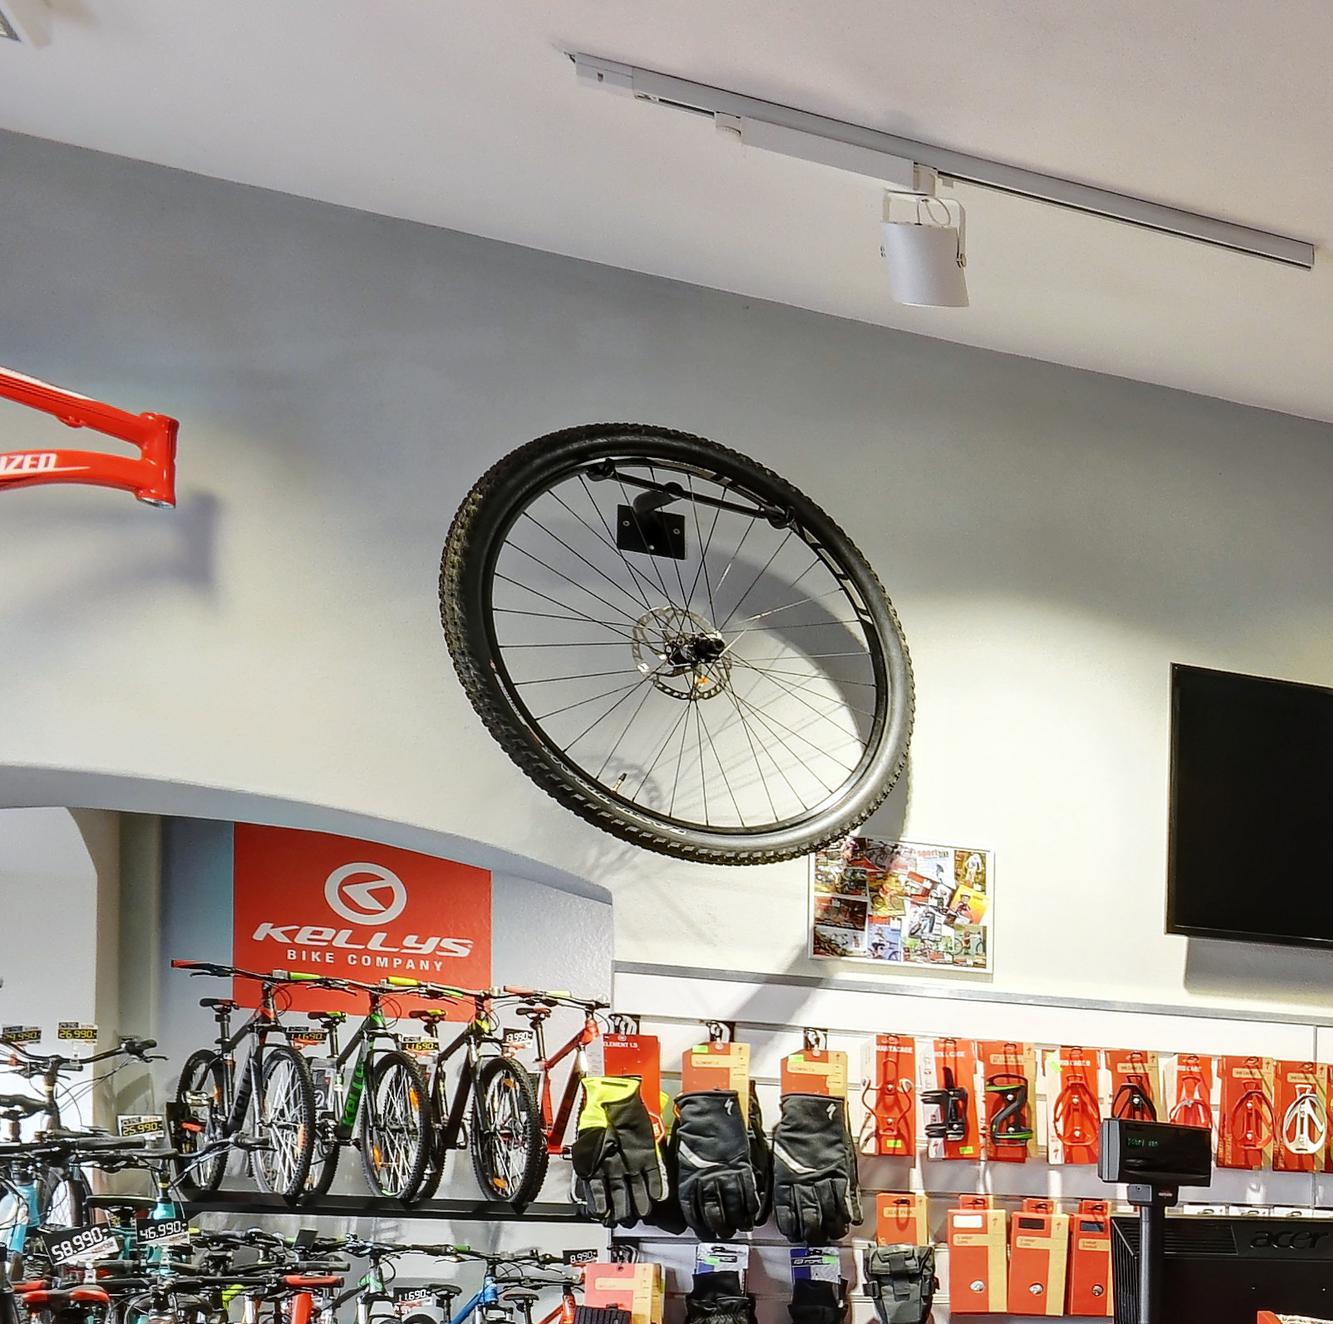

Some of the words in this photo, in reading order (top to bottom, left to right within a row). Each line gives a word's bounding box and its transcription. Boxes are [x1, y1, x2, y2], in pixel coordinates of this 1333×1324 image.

[287, 949, 335, 964] BIKE
[347, 954, 444, 972] COMPANY
[1250, 1230, 1328, 1249] acer
